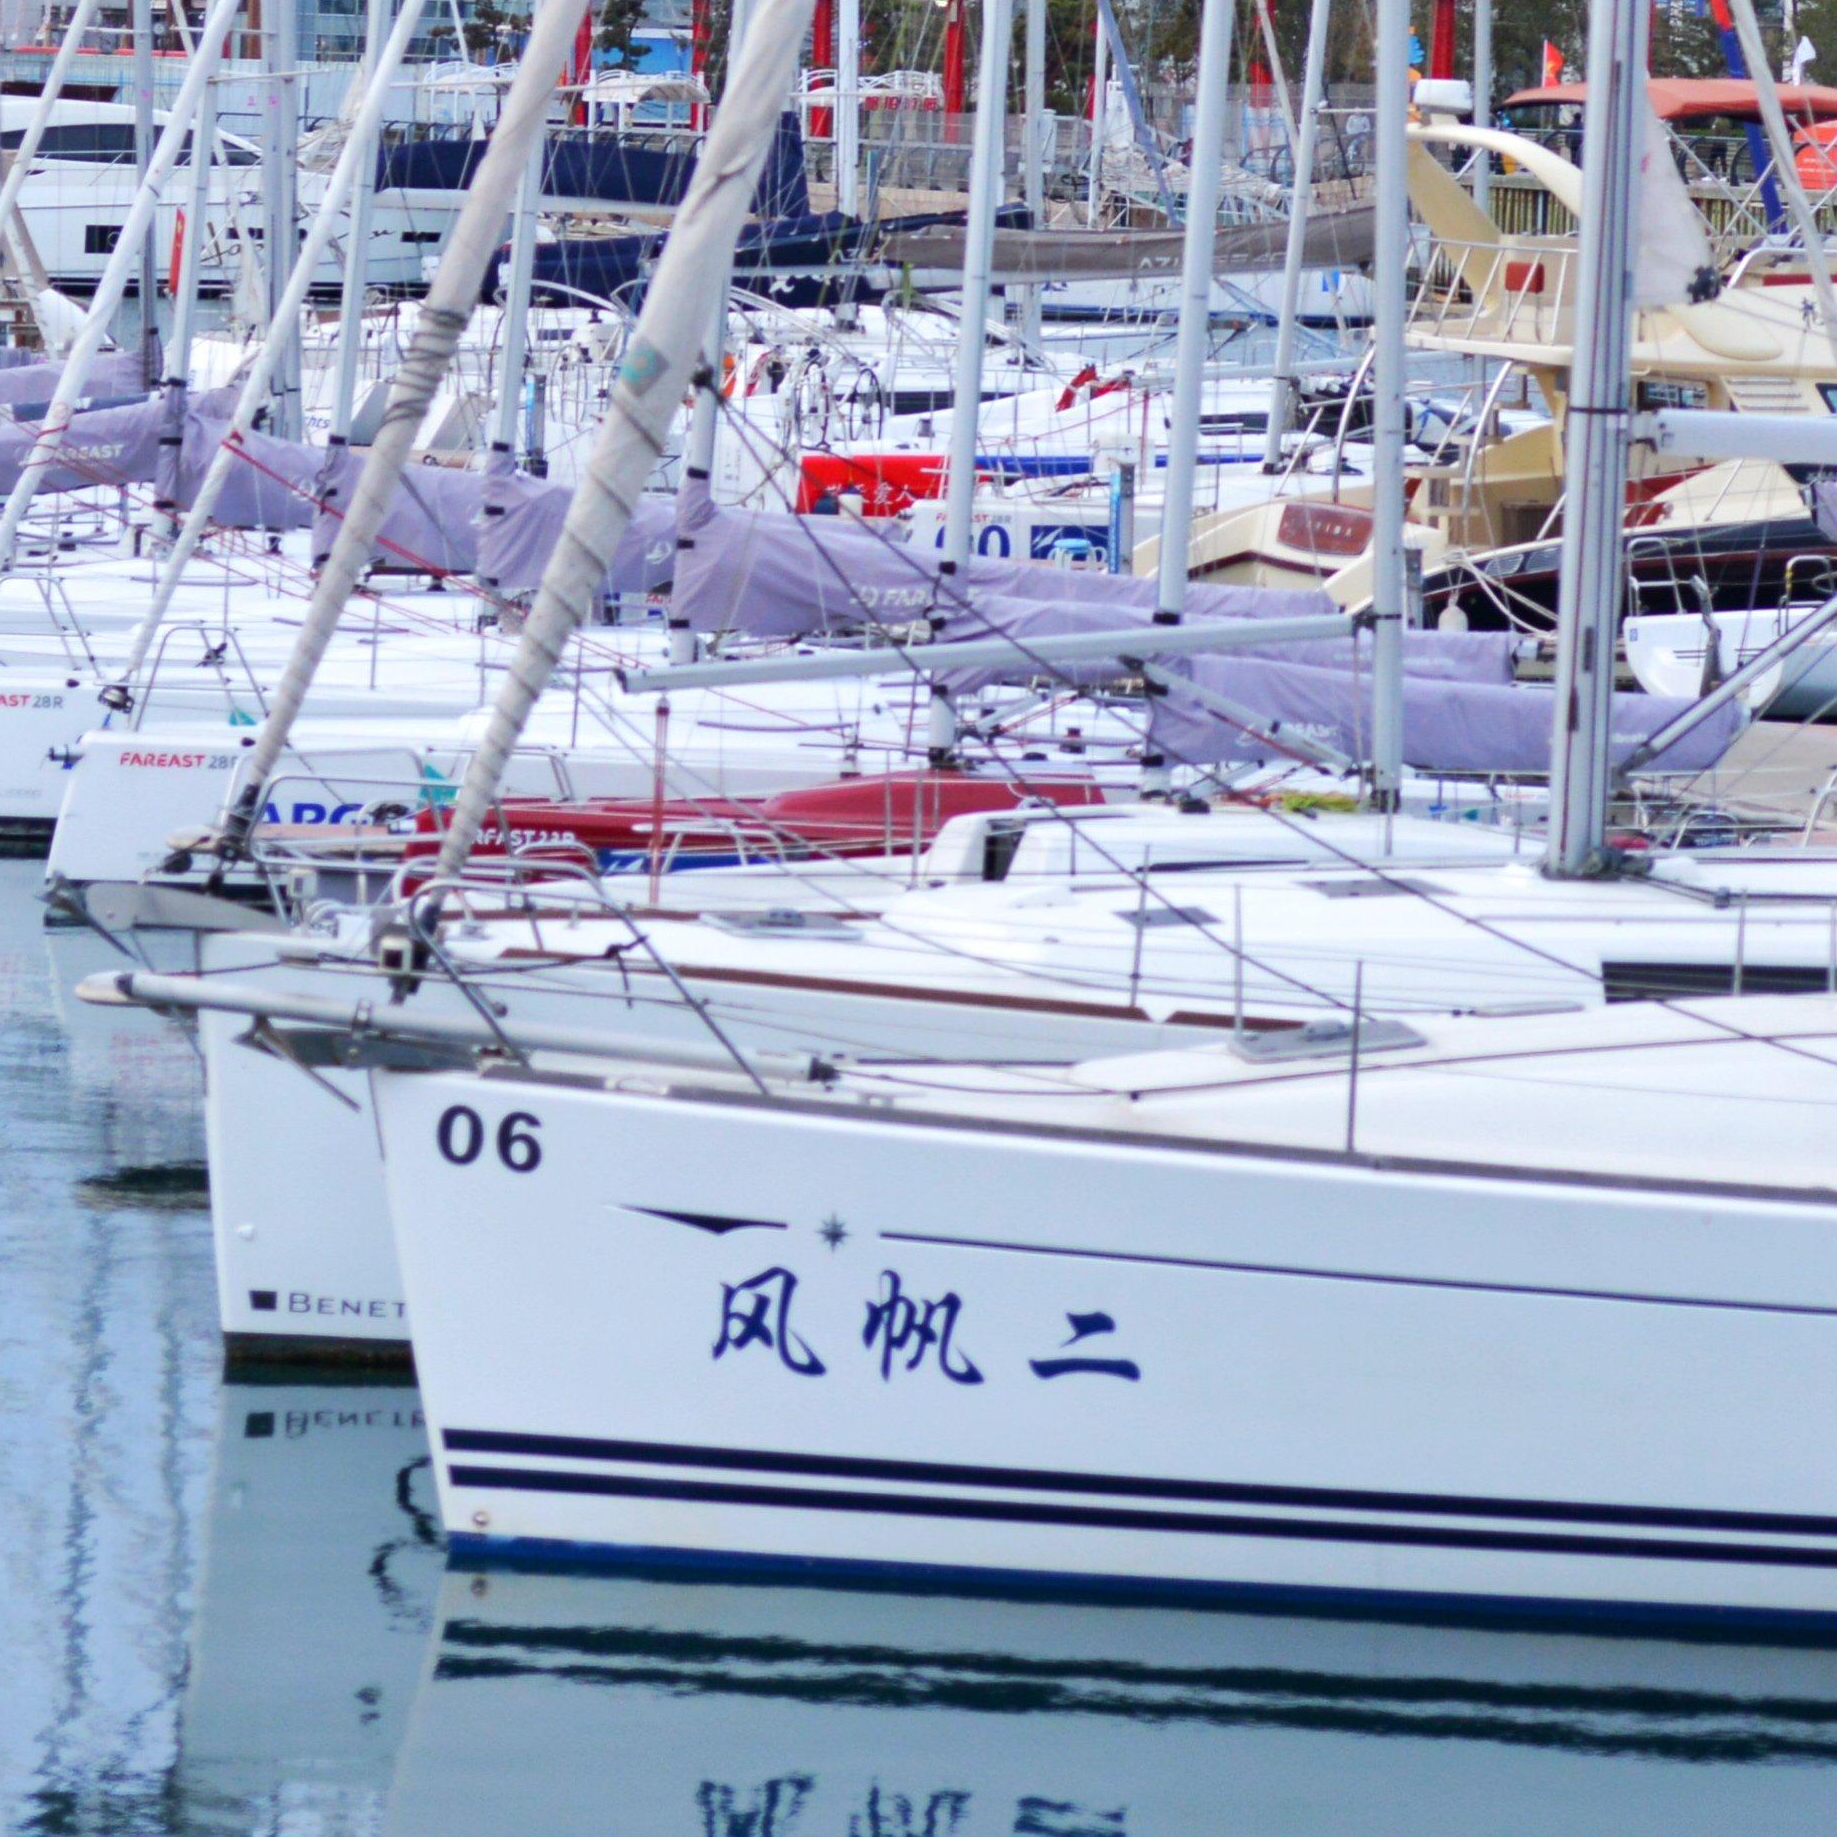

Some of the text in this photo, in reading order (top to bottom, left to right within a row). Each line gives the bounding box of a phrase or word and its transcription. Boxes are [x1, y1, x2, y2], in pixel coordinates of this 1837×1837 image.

[33, 693, 63, 709] 28R
[119, 752, 206, 768] FAREAST
[435, 1104, 544, 1173] 06
[711, 1264, 1142, 1384] 风帆二
